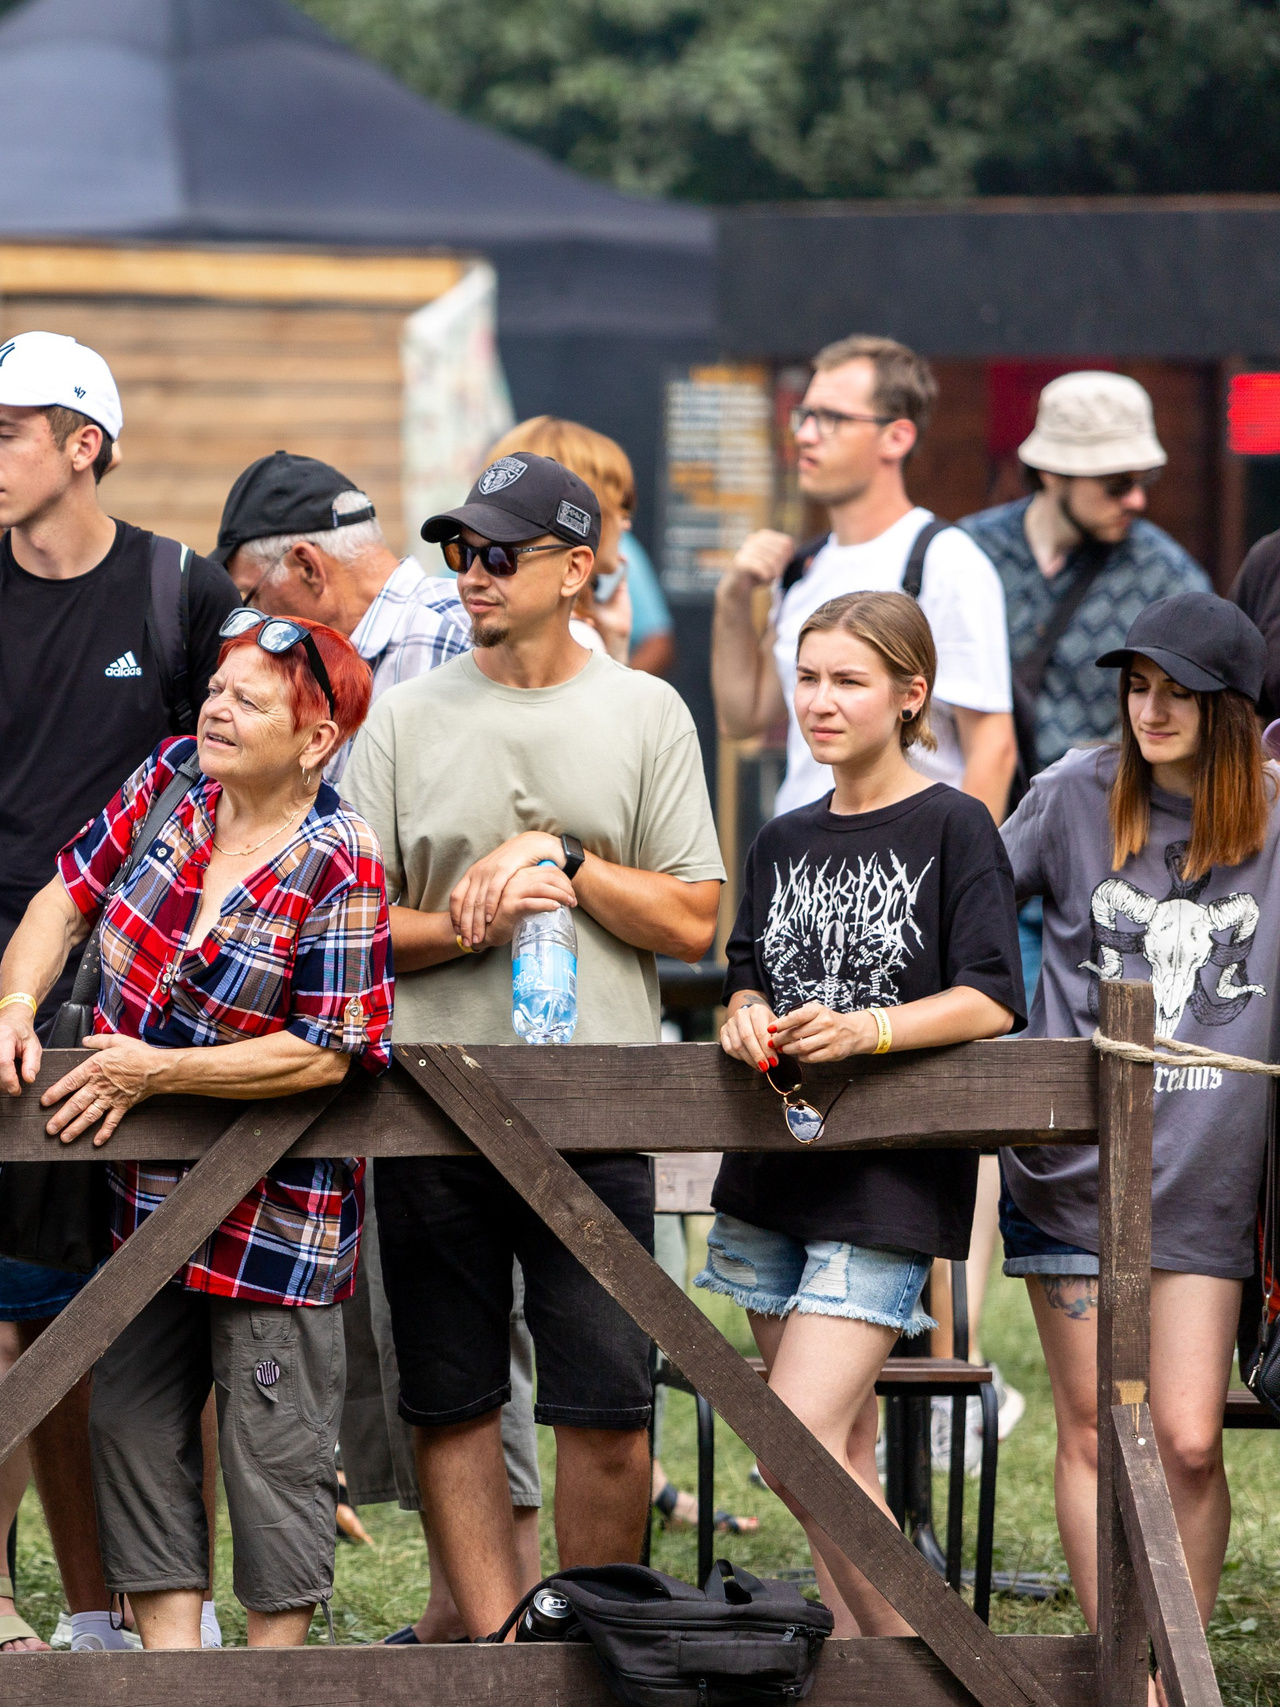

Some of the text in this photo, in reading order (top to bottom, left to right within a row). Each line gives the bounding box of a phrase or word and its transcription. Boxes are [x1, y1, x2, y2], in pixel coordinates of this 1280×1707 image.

[105, 666, 142, 677] adidas
[771, 943, 799, 977] portrait
[803, 934, 811, 947] of
[869, 969, 882, 996] thing
[1154, 1065, 1223, 1093] reams
